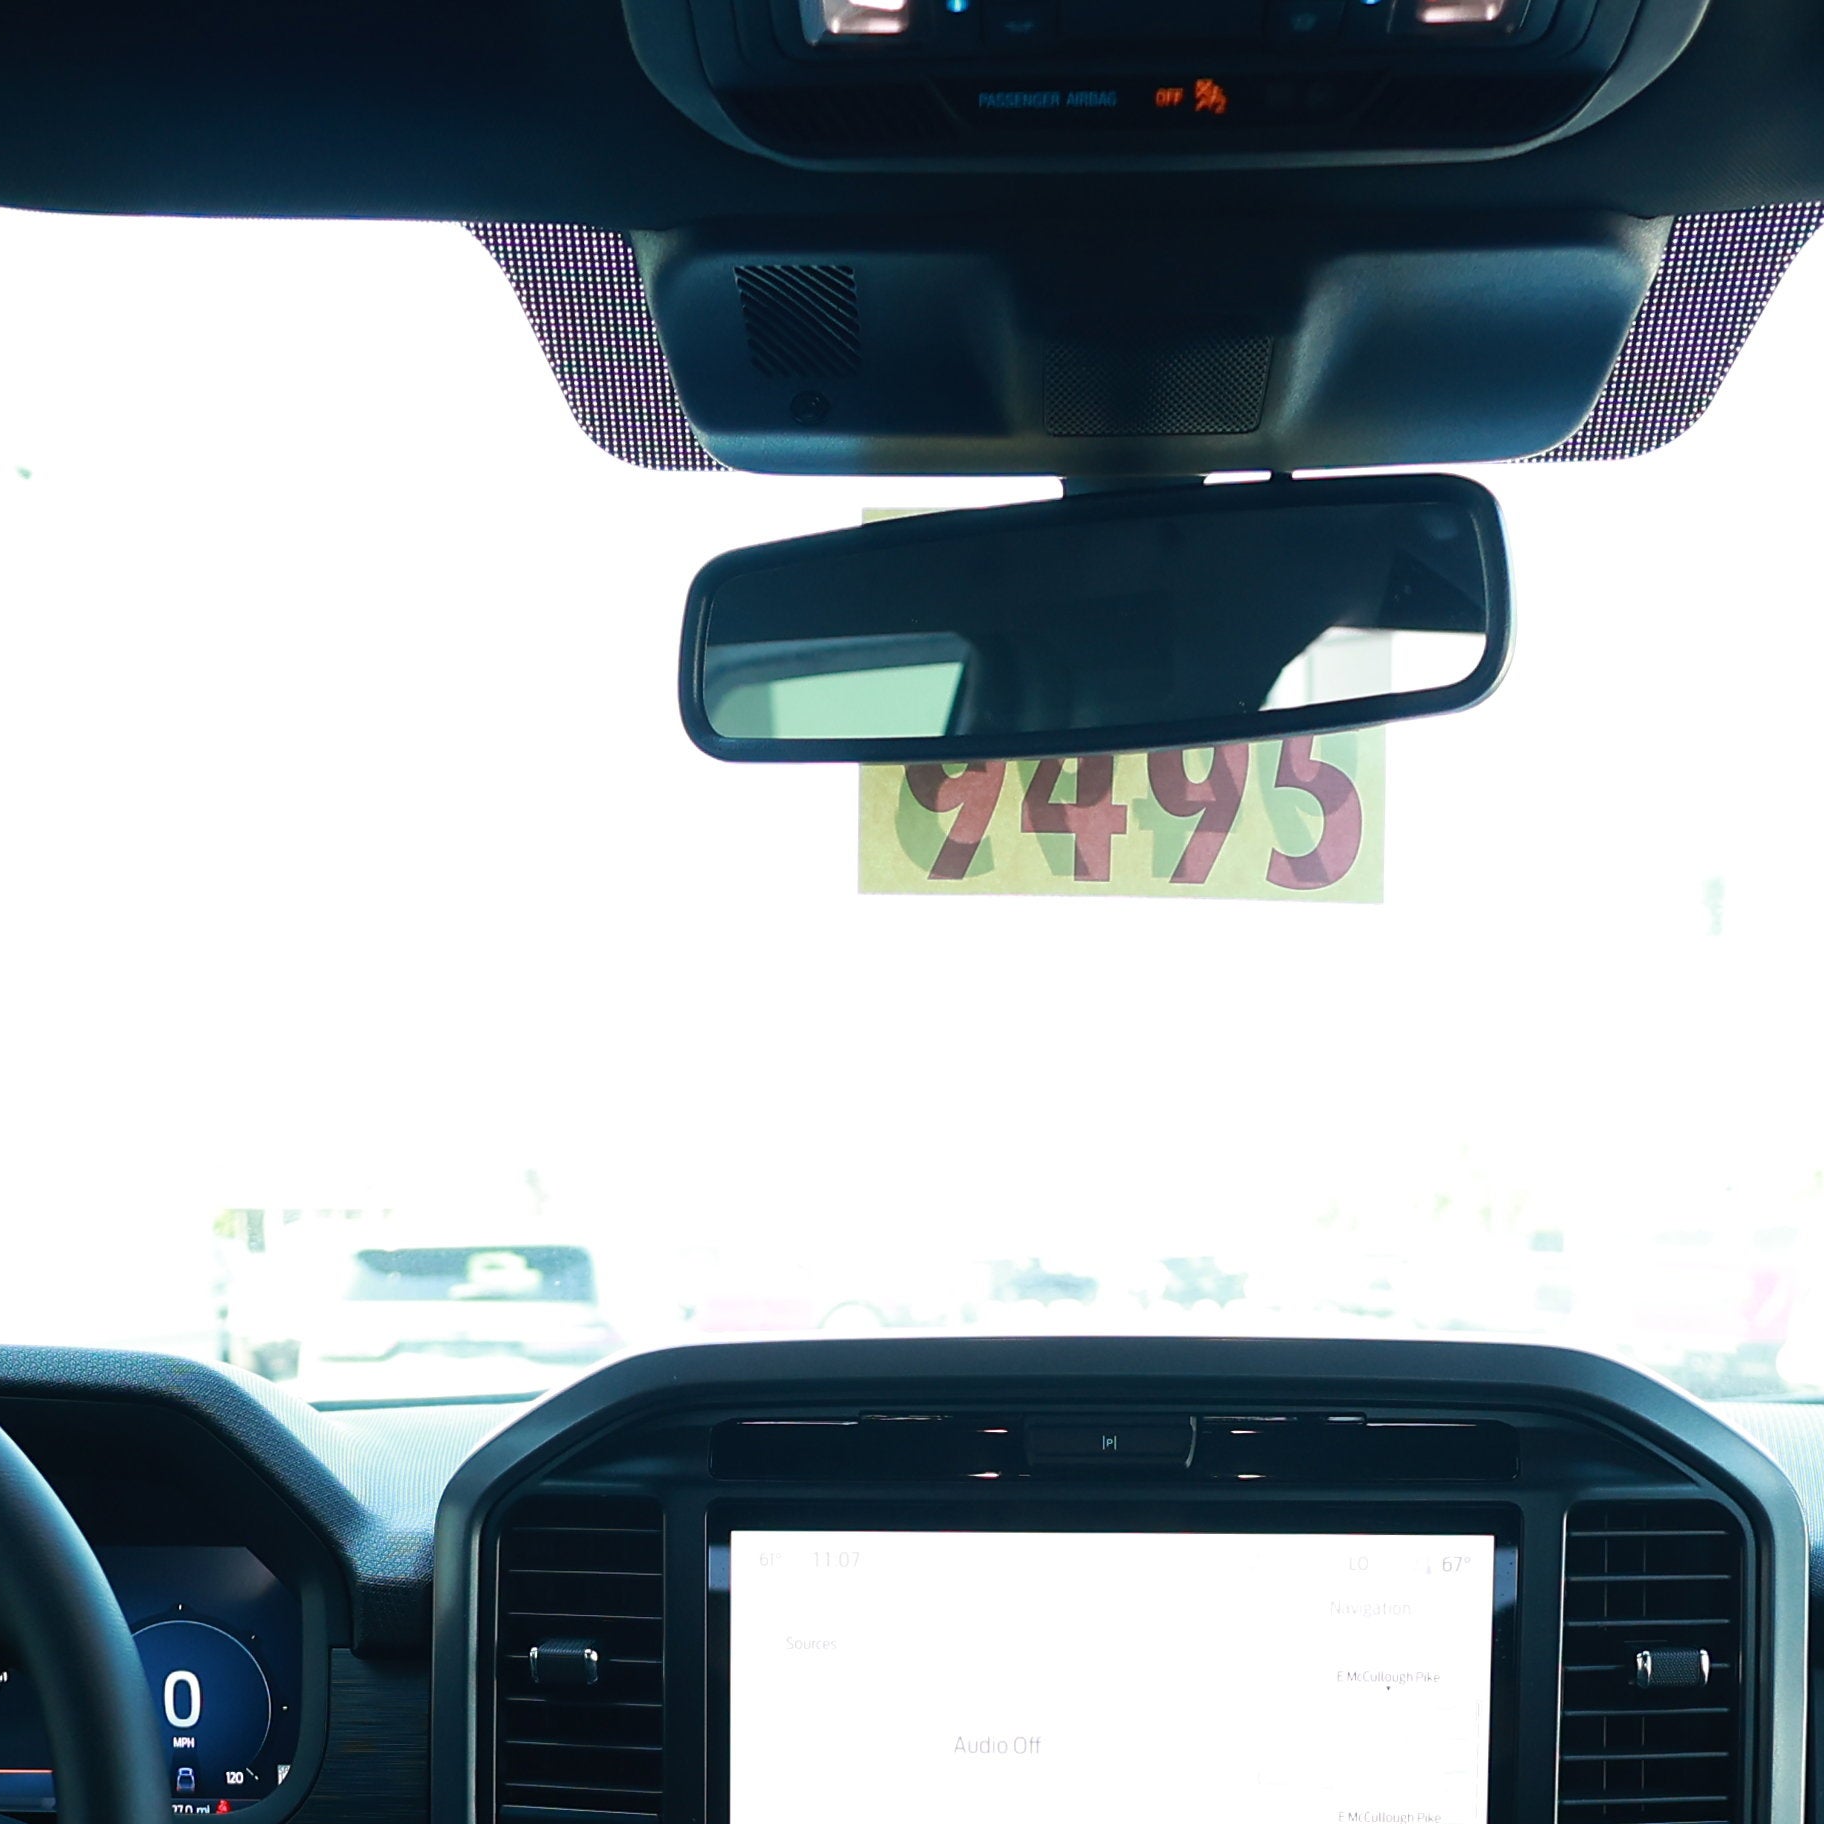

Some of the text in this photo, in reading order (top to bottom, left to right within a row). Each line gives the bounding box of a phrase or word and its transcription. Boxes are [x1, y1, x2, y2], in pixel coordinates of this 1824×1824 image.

[978, 87, 1184, 109] PASSENGER AIRBAG OFF
[903, 735, 1364, 891] 9495
[1348, 1556, 1369, 1571] LO
[1441, 1556, 1472, 1573] 67°
[1329, 1600, 1412, 1618] Navigation
[785, 1636, 838, 1650] Sources
[1346, 1671, 1413, 1685] McCullough
[1415, 1671, 1440, 1682] Pike
[163, 1669, 201, 1728] 0
[173, 1737, 195, 1748] MPH
[954, 1736, 1042, 1754] Audio Off
[225, 1770, 244, 1785] 120
[1416, 1812, 1442, 1824] Pike
